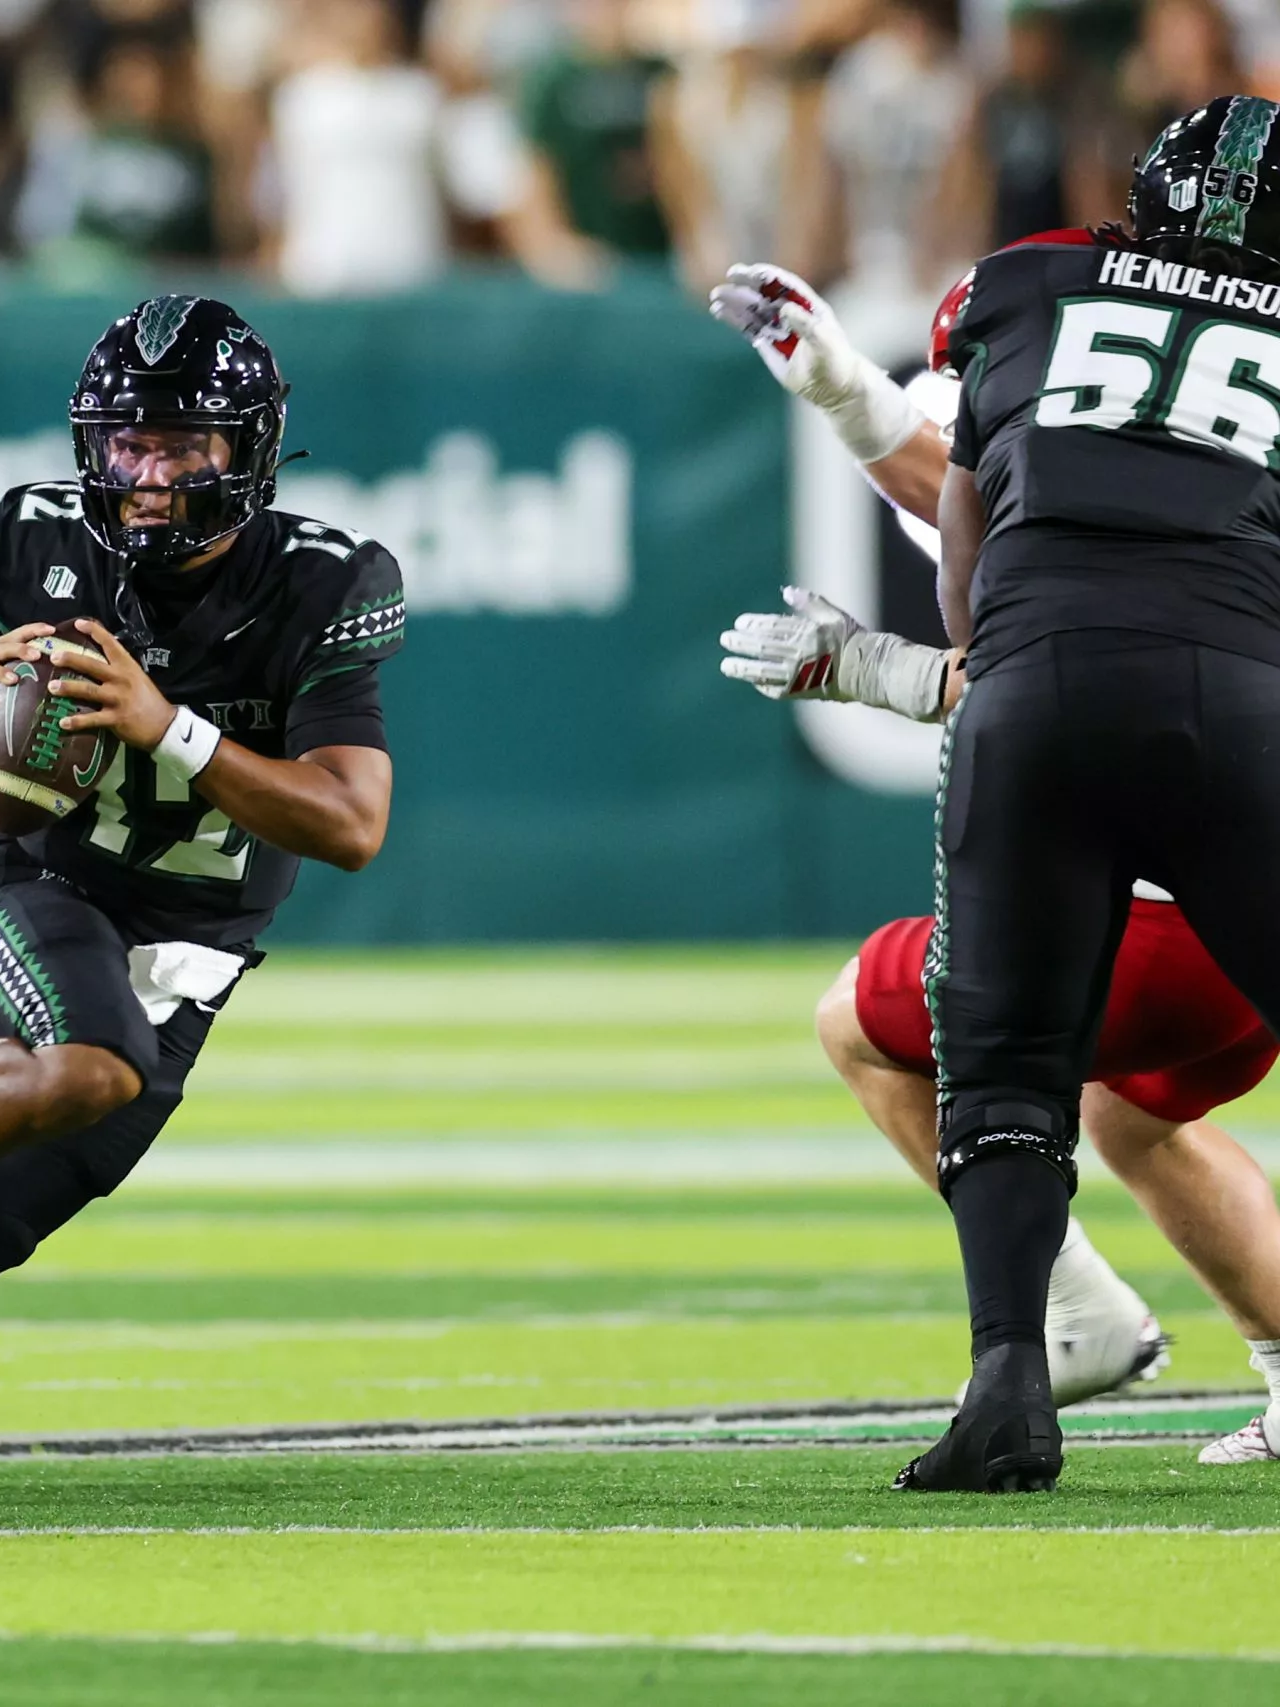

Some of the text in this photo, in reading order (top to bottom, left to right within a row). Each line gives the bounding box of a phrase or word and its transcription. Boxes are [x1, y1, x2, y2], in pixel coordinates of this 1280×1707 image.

[1202, 165, 1258, 206] 56
[1097, 250, 1280, 318] HENDERSO
[1031, 295, 1280, 470] 56
[976, 1132, 1047, 1145] DONJOY
